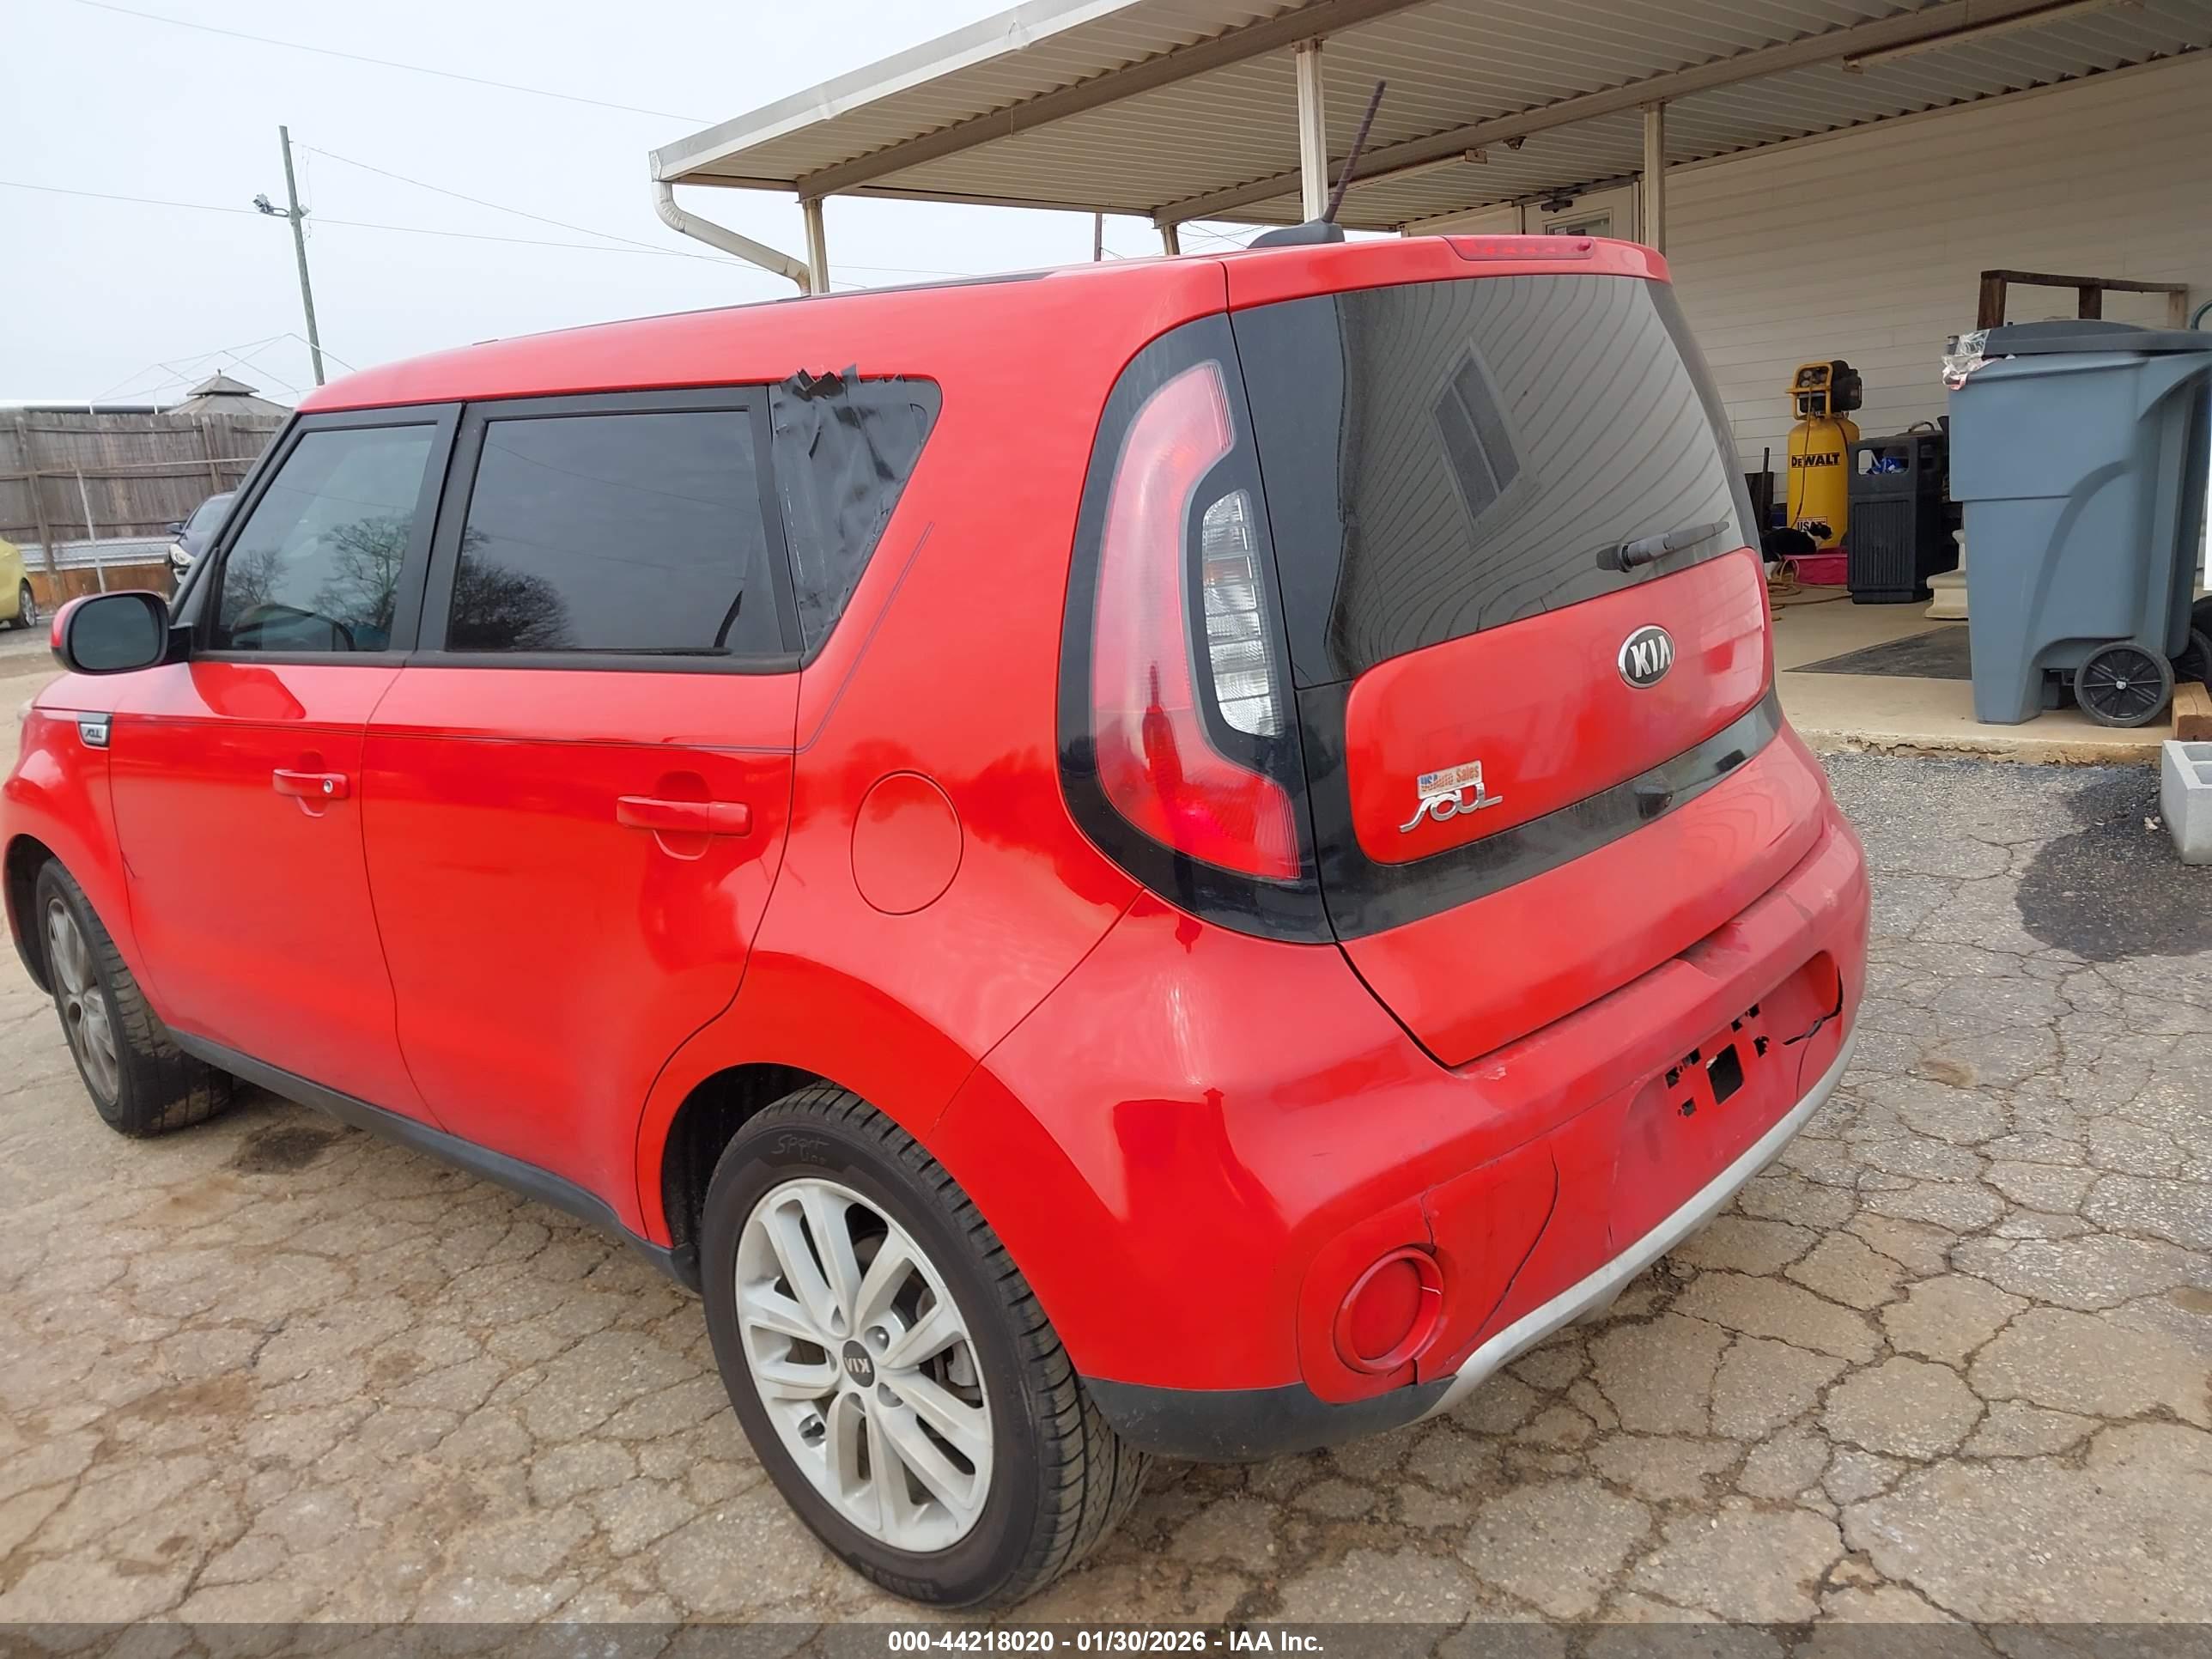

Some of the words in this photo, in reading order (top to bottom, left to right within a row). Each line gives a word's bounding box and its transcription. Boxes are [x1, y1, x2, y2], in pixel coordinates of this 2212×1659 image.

[1630, 635, 1671, 678] KIA
[1455, 765, 1480, 783] Sales
[1399, 782, 1504, 833] SOUL
[843, 1357, 872, 1374] KIA
